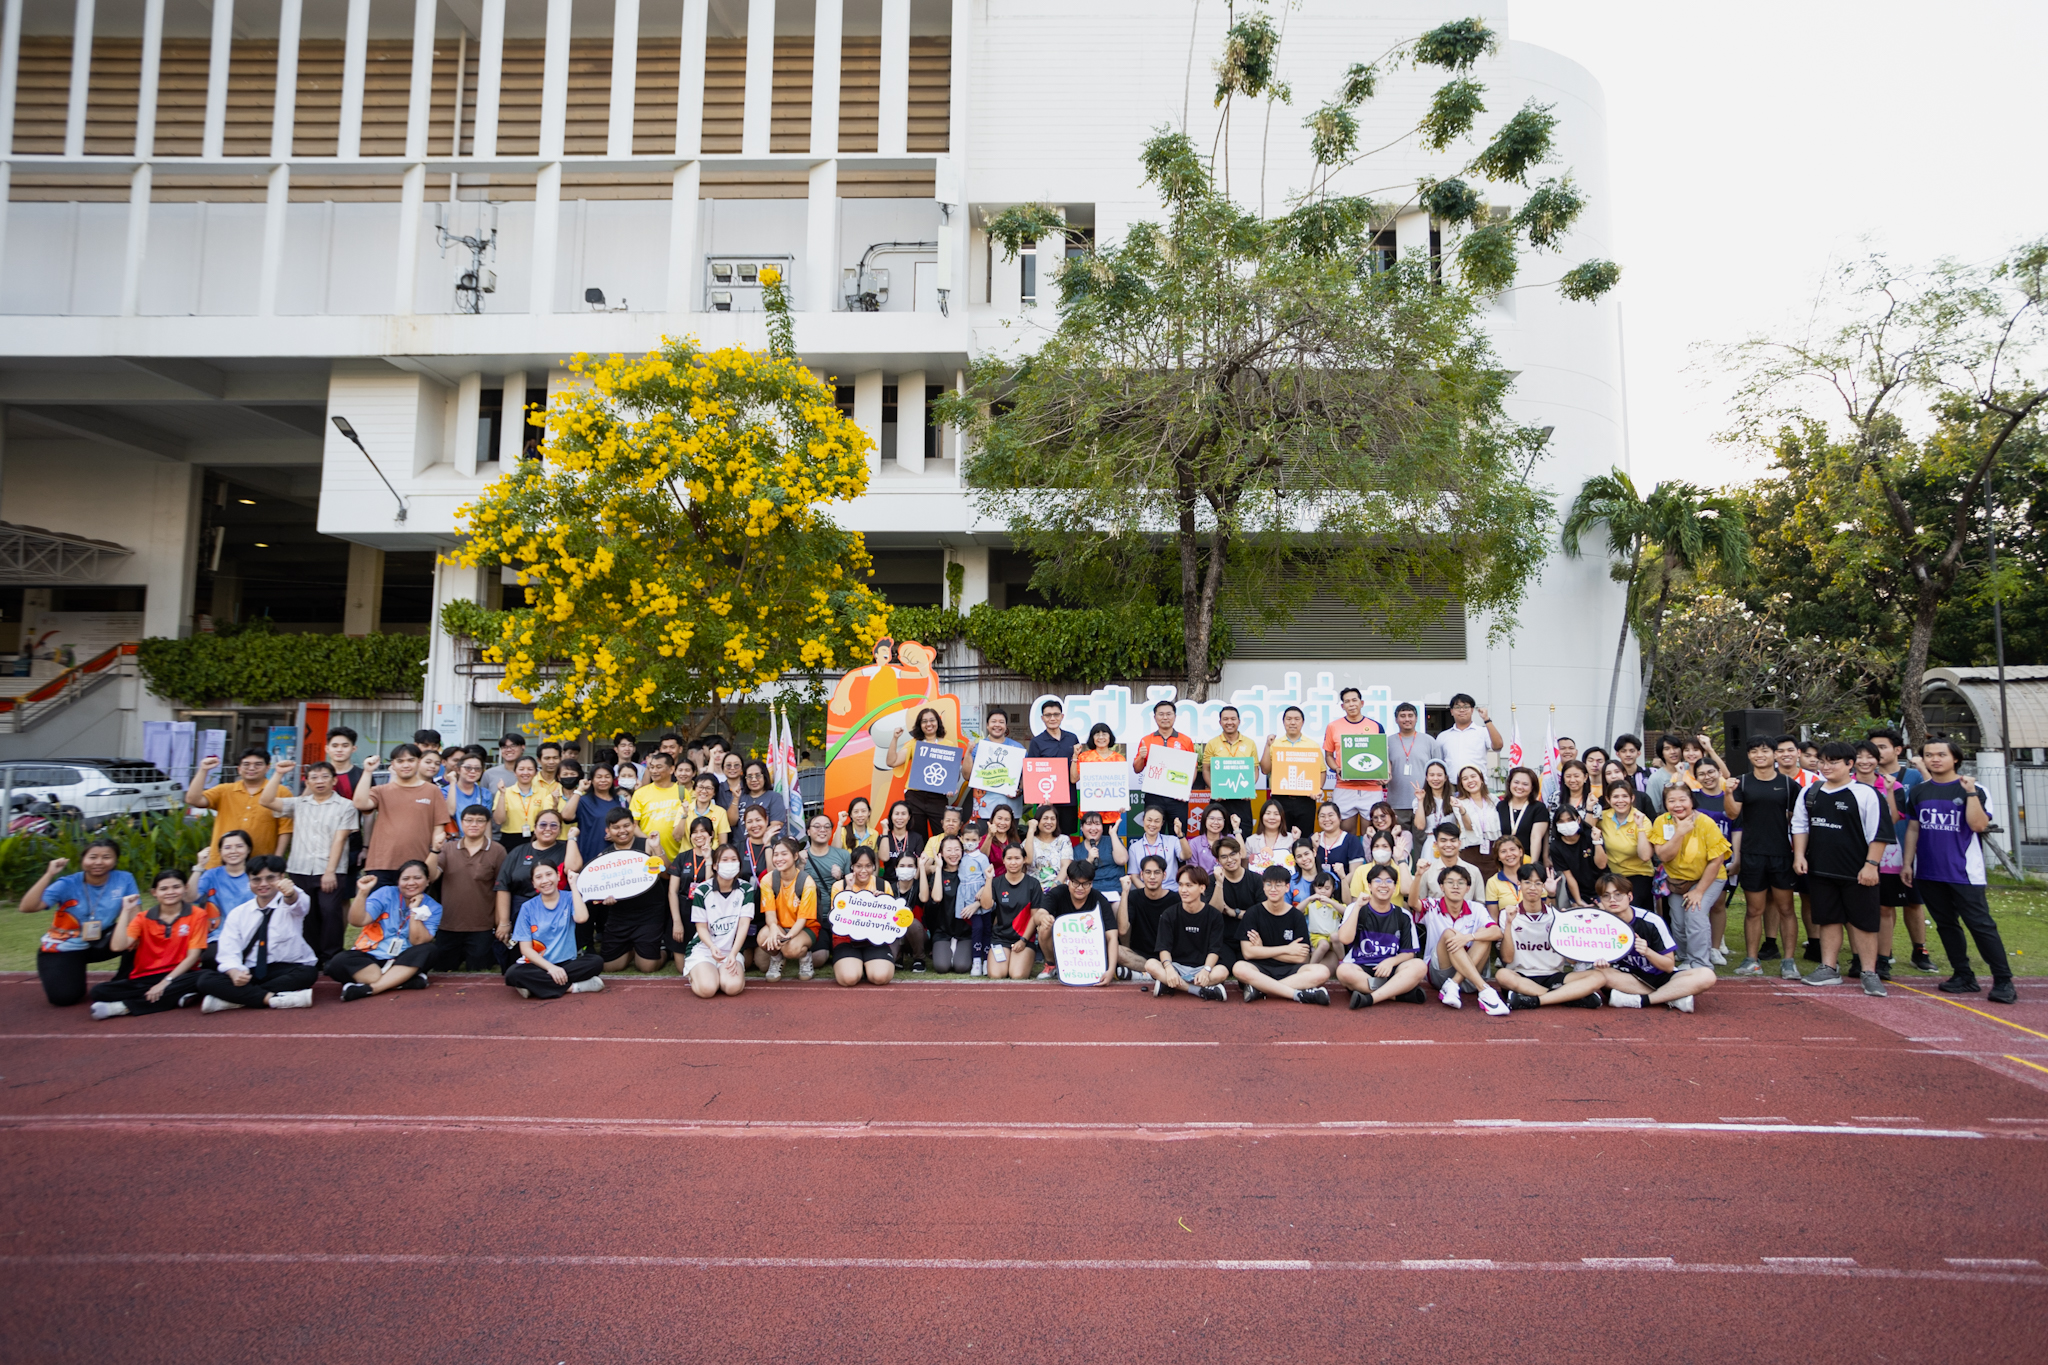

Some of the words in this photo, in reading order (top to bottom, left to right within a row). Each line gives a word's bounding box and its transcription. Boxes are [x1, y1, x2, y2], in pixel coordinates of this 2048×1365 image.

[1343, 737, 1353, 748] 13
[920, 746, 929, 757] 17
[1276, 751, 1284, 762] 11
[1026, 761, 1033, 772] 5
[1214, 759, 1221, 770] 3
[1083, 787, 1126, 798] GOALS
[1919, 808, 1961, 826] Civil
[588, 856, 643, 873] ออกกำลังกาย
[601, 868, 633, 881] วันละนิด
[581, 873, 654, 894] แค่คิดก็เหนื่อยแล้ว
[848, 895, 898, 912] ไม่ต้องมีหรอก
[852, 909, 888, 920] เทรนเนอร์
[1062, 918, 1092, 933] เดิน
[1558, 923, 1618, 936] เดินหลายโล
[1061, 934, 1094, 944] ด้วยกัน
[1556, 935, 1623, 950] แต่ไม่หลายใจ
